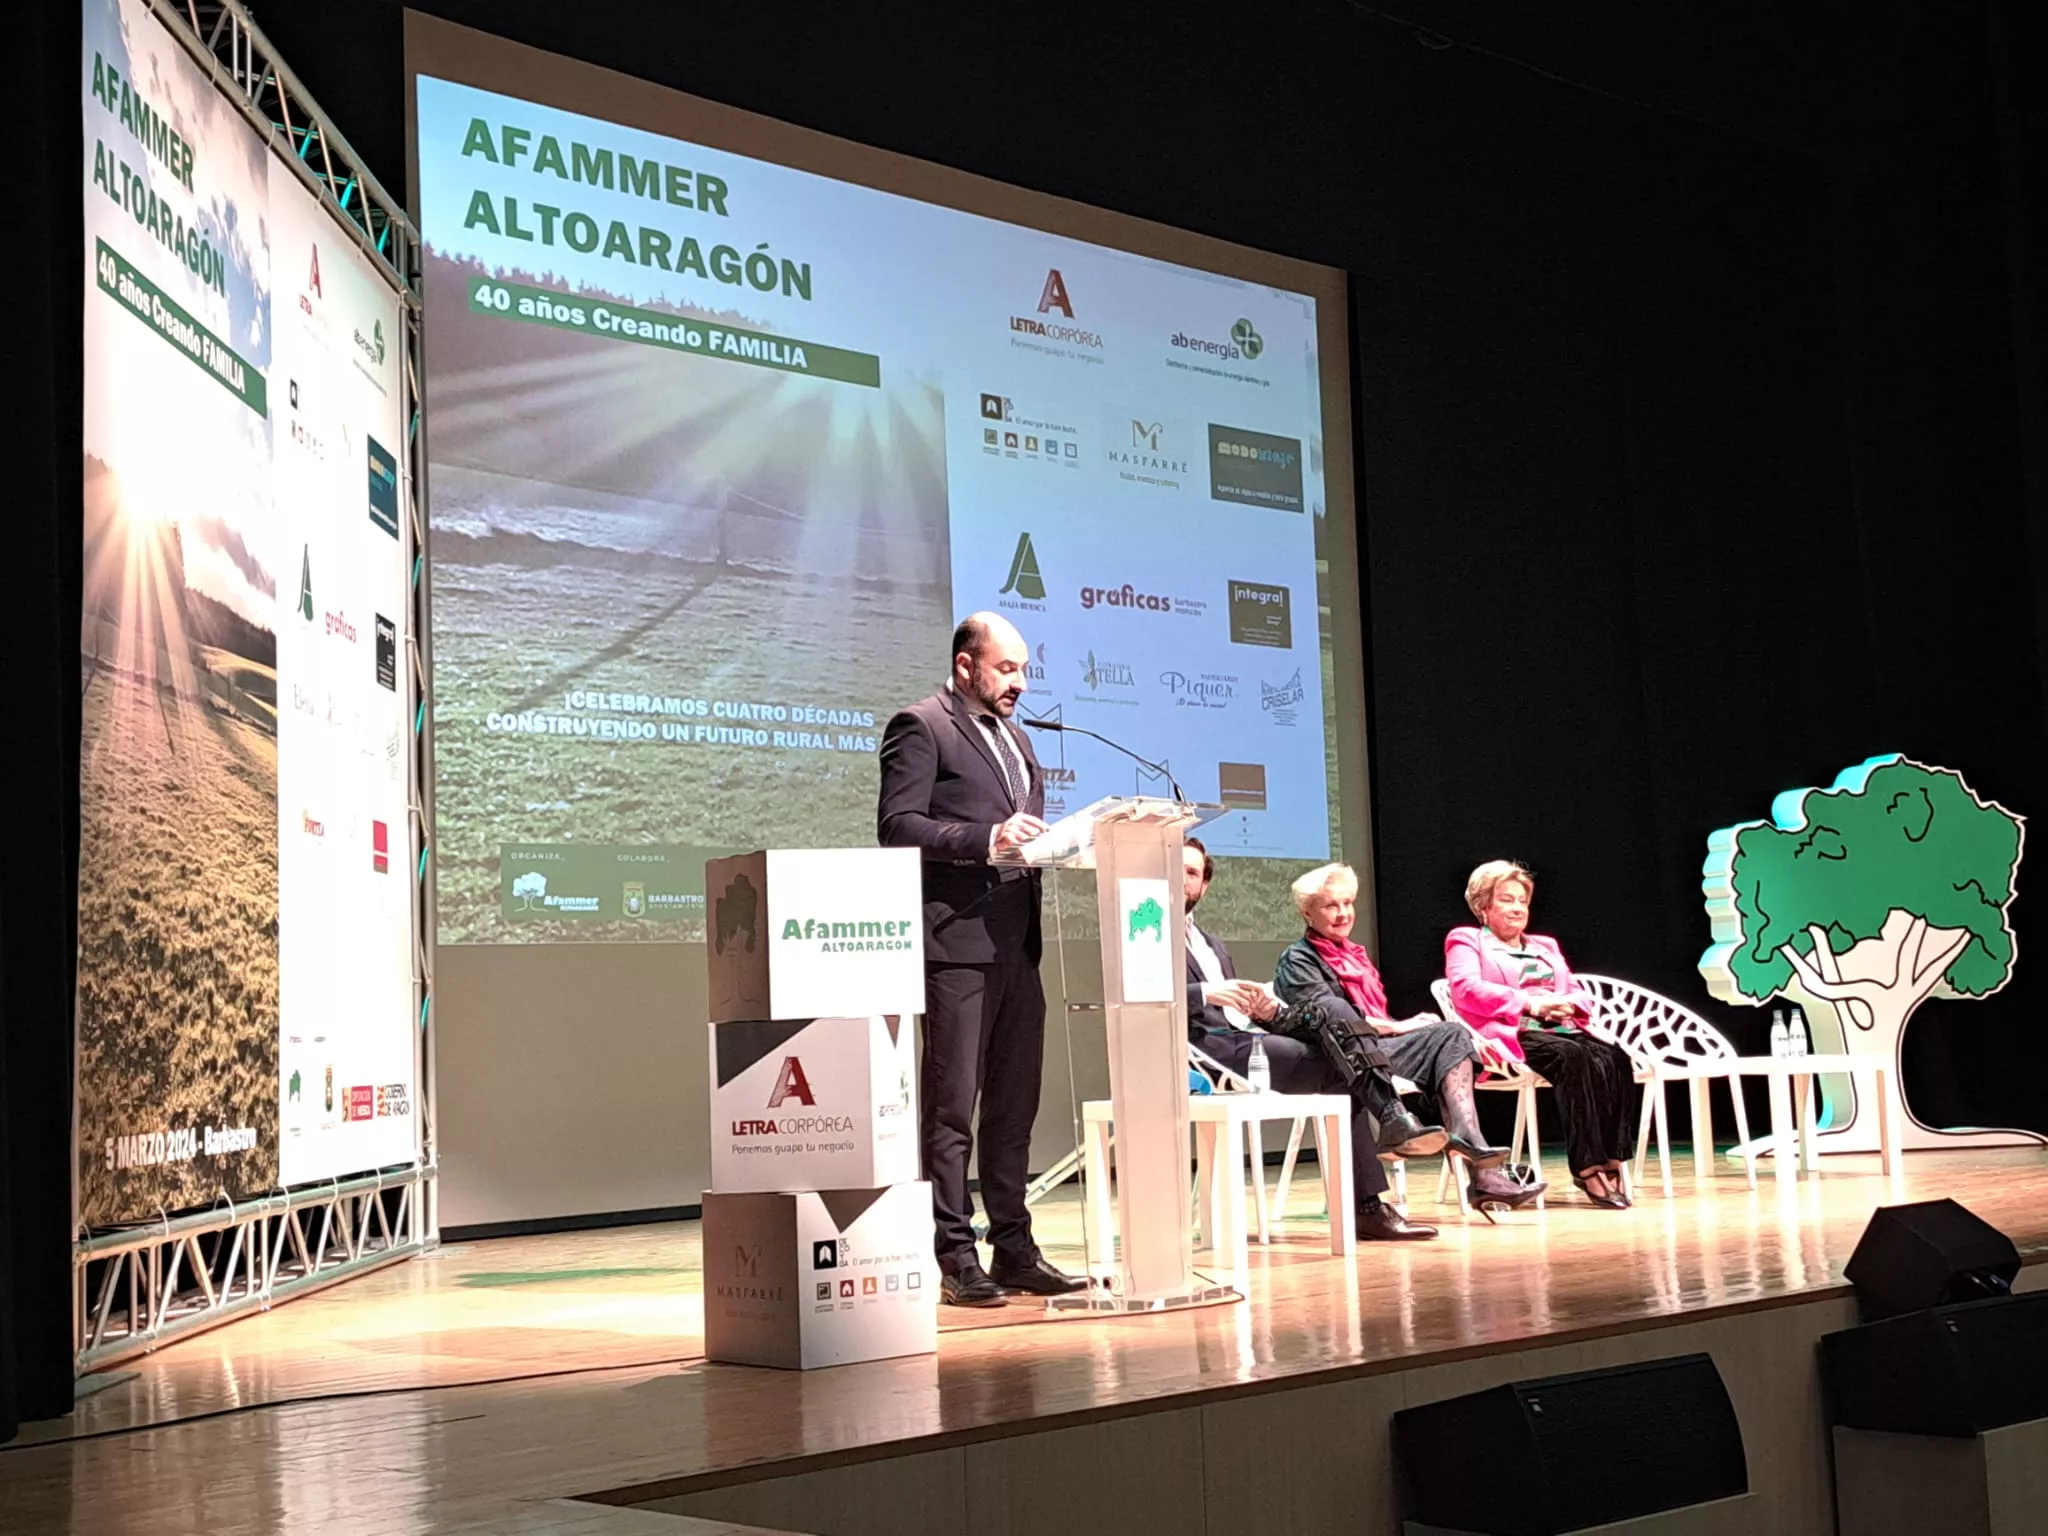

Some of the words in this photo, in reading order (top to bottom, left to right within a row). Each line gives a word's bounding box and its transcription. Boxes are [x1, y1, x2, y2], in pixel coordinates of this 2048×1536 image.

[92, 51, 194, 194] AFAMMER
[461, 117, 730, 217] AFAMMER
[93, 138, 225, 299] ALTOARAGÓN
[463, 189, 812, 301] ALTOARAGÓN
[99, 250, 117, 289] 40
[119, 271, 151, 317] años
[152, 294, 201, 358] Creando
[202, 334, 246, 395] FAMILIA
[475, 284, 511, 311] 40
[518, 295, 586, 326] años
[592, 307, 702, 348] Creando
[709, 330, 807, 369] FAMILIA
[486, 711, 657, 740] CONSTRUYENDO
[662, 723, 689, 742] UN
[695, 725, 769, 746] FUTURO
[773, 730, 834, 750] RURAL
[838, 732, 876, 753] MÁS
[712, 700, 787, 721] CUATRO
[791, 704, 875, 728] DÉCADAS
[782, 918, 912, 940] Afammer
[105, 1136, 115, 1171] 5
[117, 1132, 165, 1169] MARZO
[166, 1127, 198, 1162] 2024
[204, 1124, 257, 1156] Barbastro
[731, 1143, 773, 1155] Ponemos
[774, 1142, 803, 1155] guapo
[806, 1141, 816, 1151] tu
[818, 1140, 855, 1153] negocio
